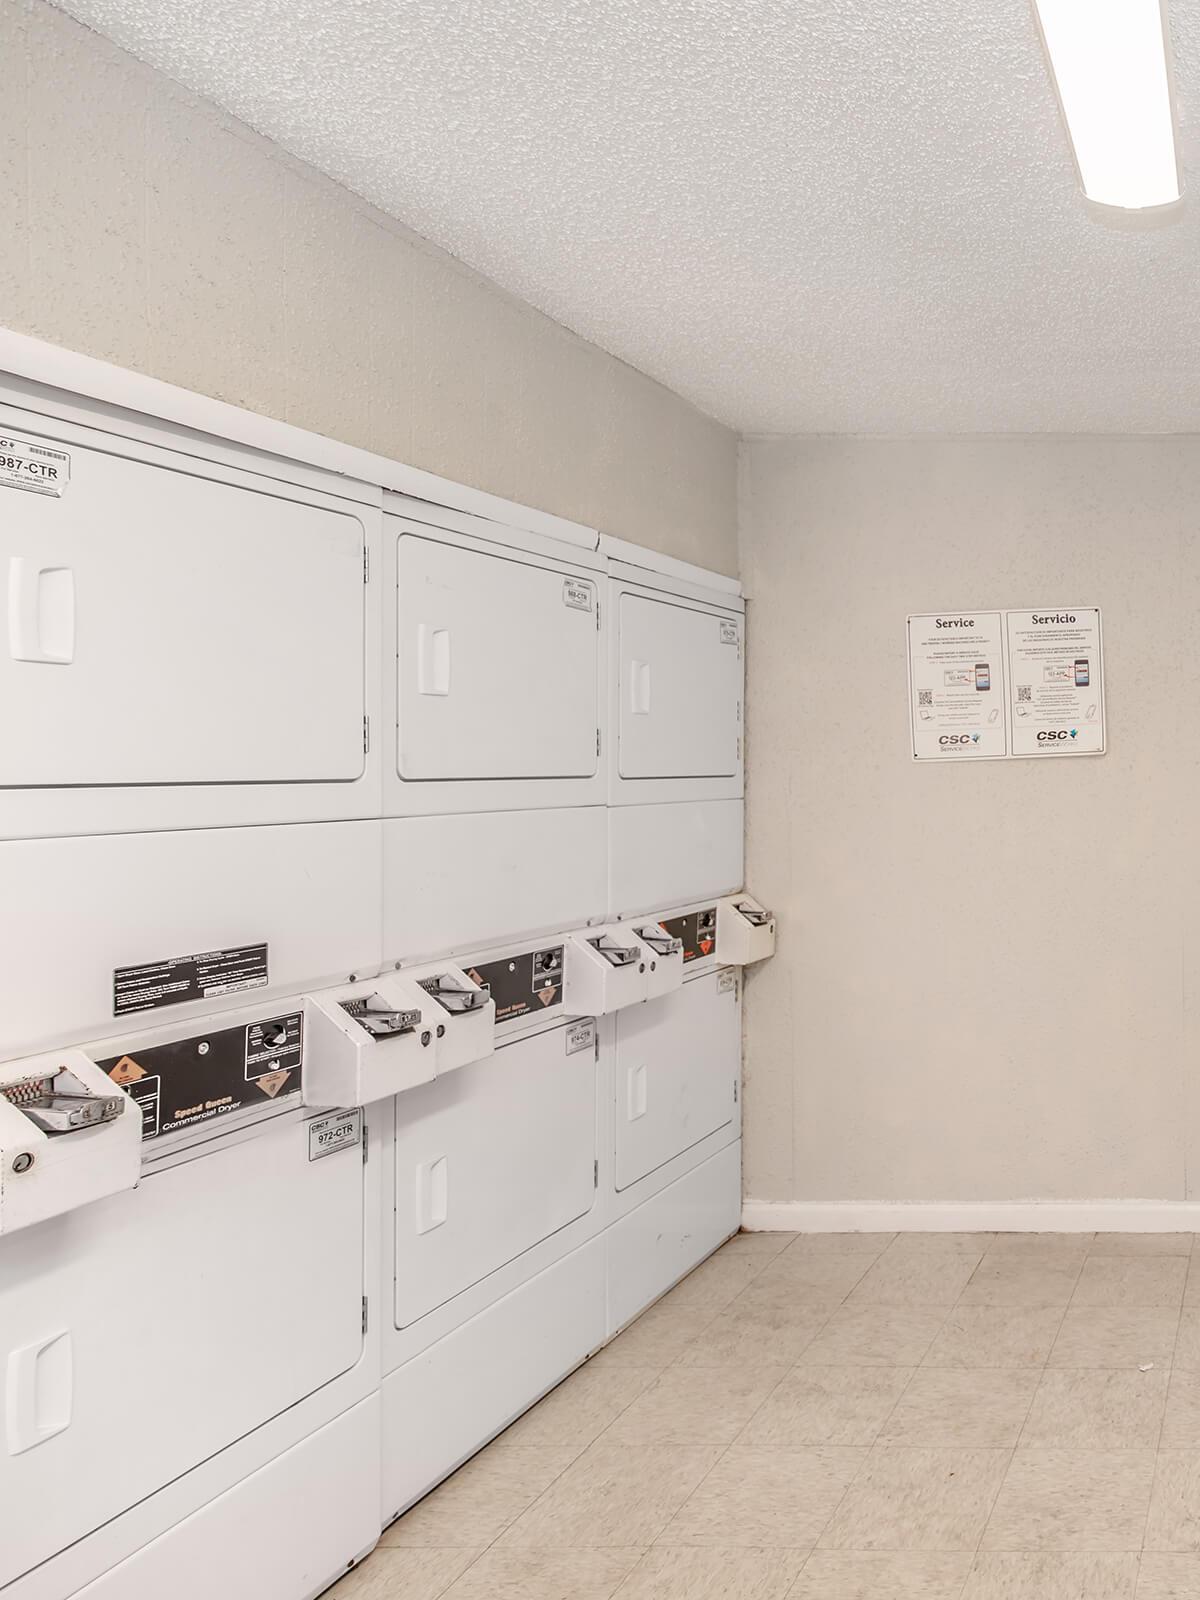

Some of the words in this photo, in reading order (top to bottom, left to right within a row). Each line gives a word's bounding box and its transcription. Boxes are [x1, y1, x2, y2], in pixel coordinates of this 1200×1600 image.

[936, 618, 975, 628] Service
[1032, 614, 1076, 624] Servicio
[938, 734, 971, 745] CSC
[1036, 730, 1068, 740] CSC
[174, 1103, 203, 1118] Speed
[205, 1096, 232, 1109] Queen
[162, 1109, 216, 1131] Commercial
[218, 1100, 242, 1113] Dryer
[318, 1124, 353, 1144] 972-CTR
